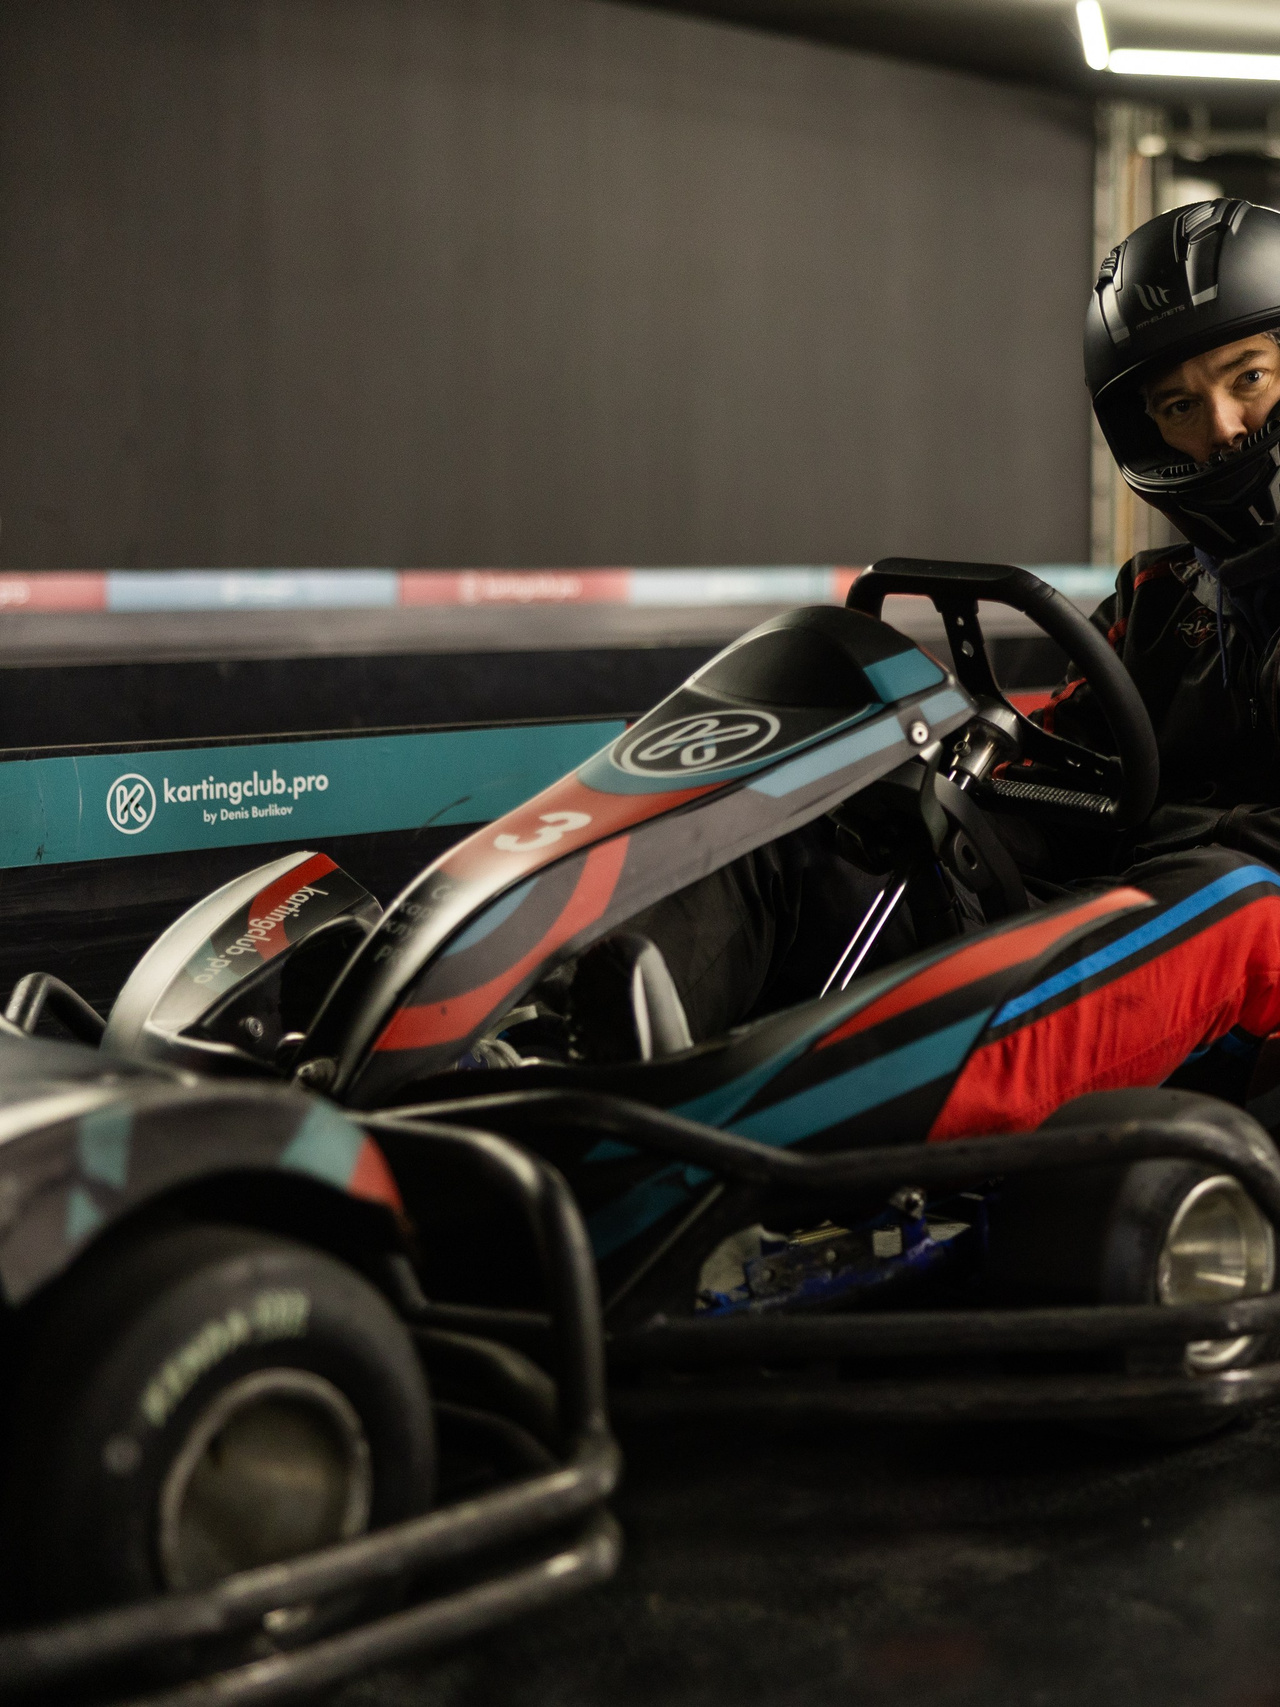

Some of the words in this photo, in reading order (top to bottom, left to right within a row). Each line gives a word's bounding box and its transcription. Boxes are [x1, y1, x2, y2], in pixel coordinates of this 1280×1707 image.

[163, 769, 329, 805] kartingclub.pro
[203, 809, 218, 825] by
[220, 806, 250, 821] Denis
[251, 803, 294, 819] Burlikov
[493, 811, 593, 852] 3
[193, 886, 329, 984] kartingclub.pro
